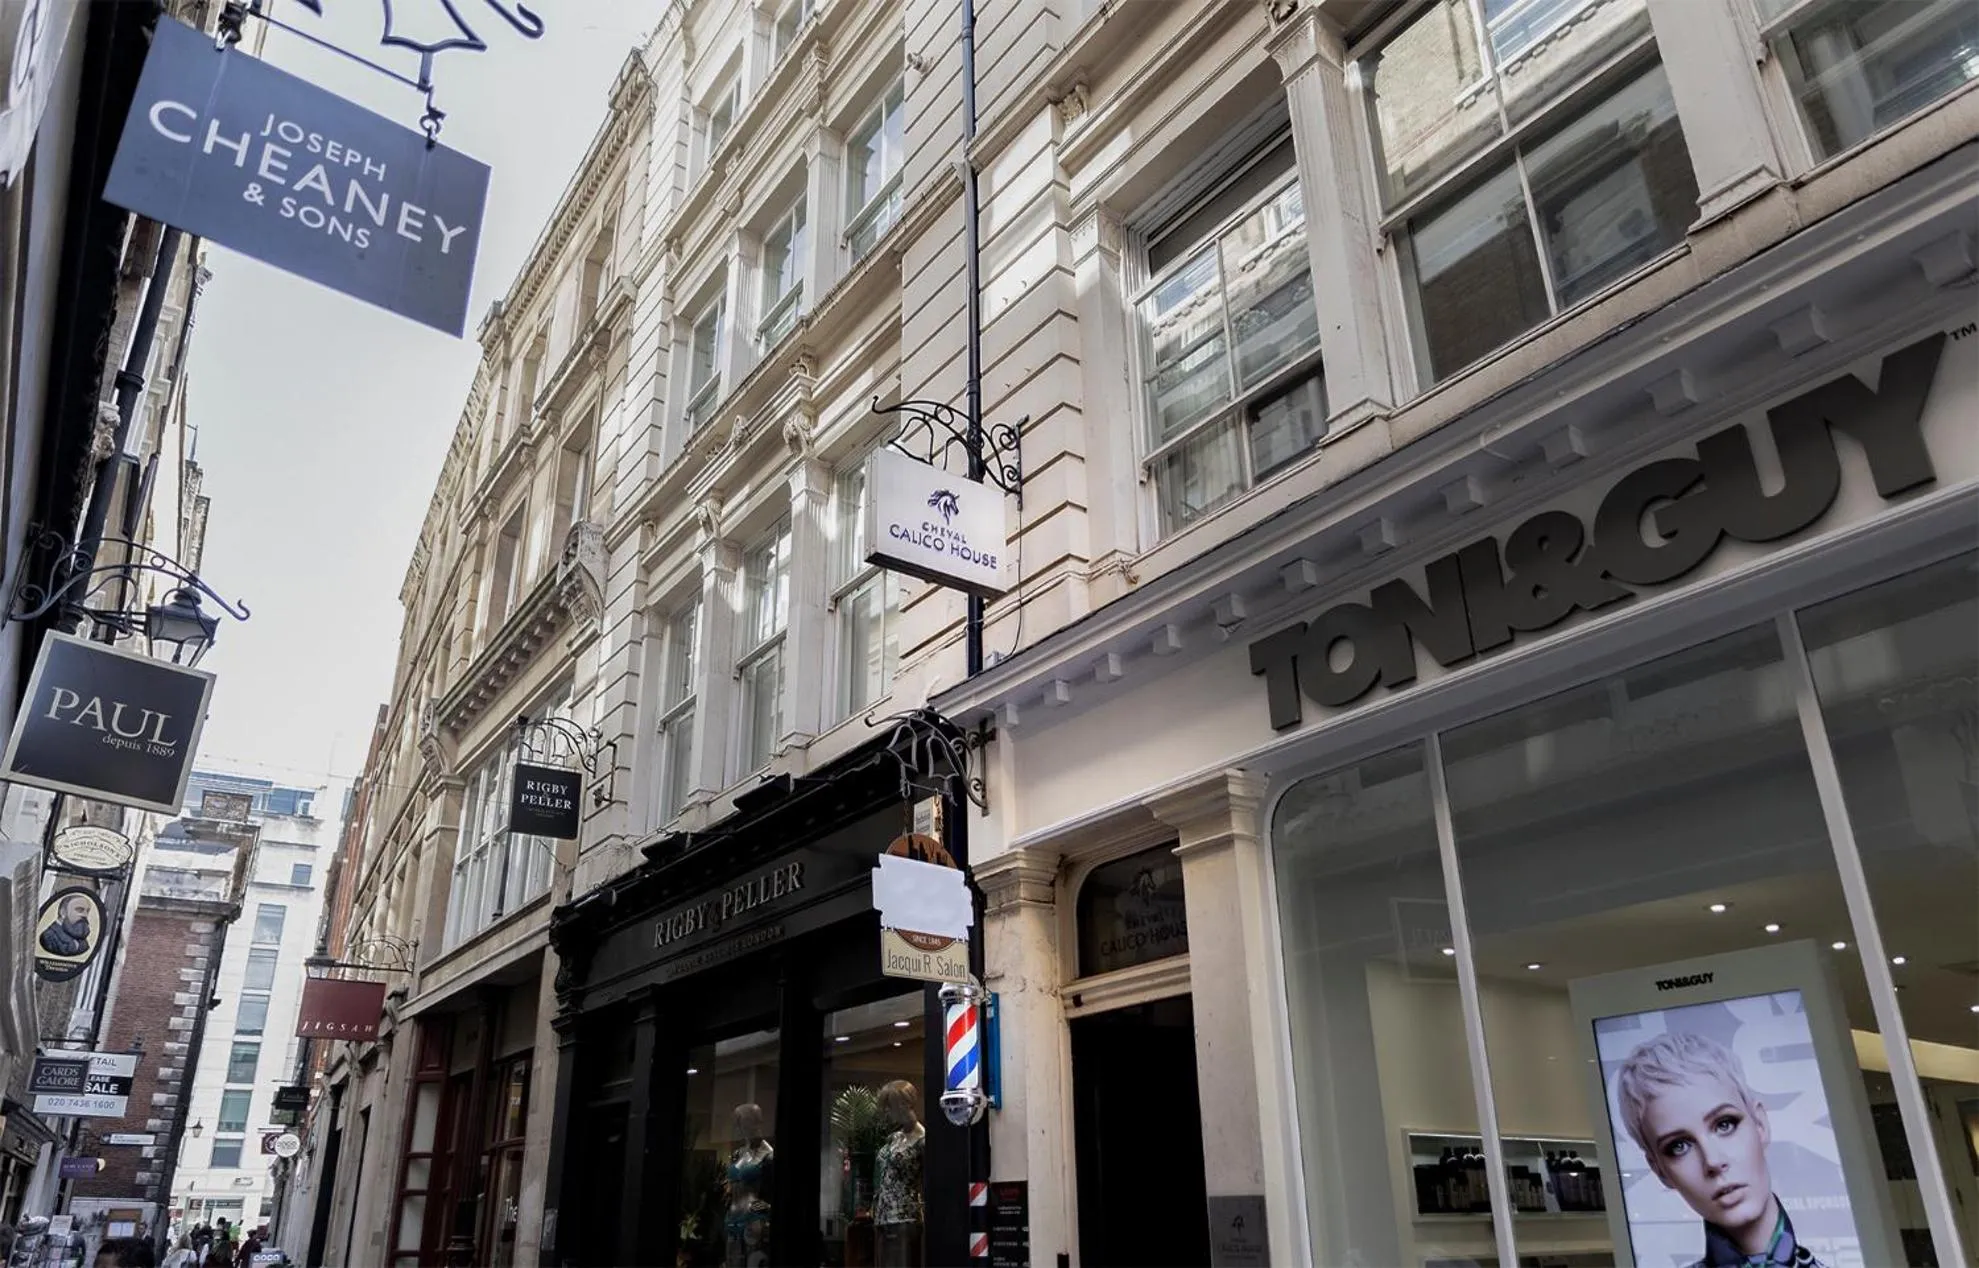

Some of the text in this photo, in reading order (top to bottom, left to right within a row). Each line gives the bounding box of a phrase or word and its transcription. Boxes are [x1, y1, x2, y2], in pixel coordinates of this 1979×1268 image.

[259, 112, 386, 182] JOSEPH
[148, 100, 466, 254] CHEANEY
[243, 183, 371, 249] & SONS
[922, 521, 967, 544] CHEVAL
[1249, 331, 1948, 731] TONI&GUY
[889, 524, 997, 569] CALICO HOUSE
[44, 686, 177, 747] PAUL
[102, 734, 175, 758] depuis 1889
[527, 780, 568, 795] RIGBY
[520, 793, 572, 809] PELLER
[654, 902, 709, 948] RIGBY
[721, 861, 802, 920] PELLER
[1150, 921, 1187, 944] HOUS
[888, 949, 966, 978] Jacqui R Salon
[1655, 972, 1713, 991] TONI&GUY
[302, 1021, 374, 1033] JIGSAW
[36, 1076, 81, 1087] GALORE
[42, 1066, 80, 1077] CARDS
[84, 1082, 119, 1094] SALE
[48, 1097, 65, 1106] 020
